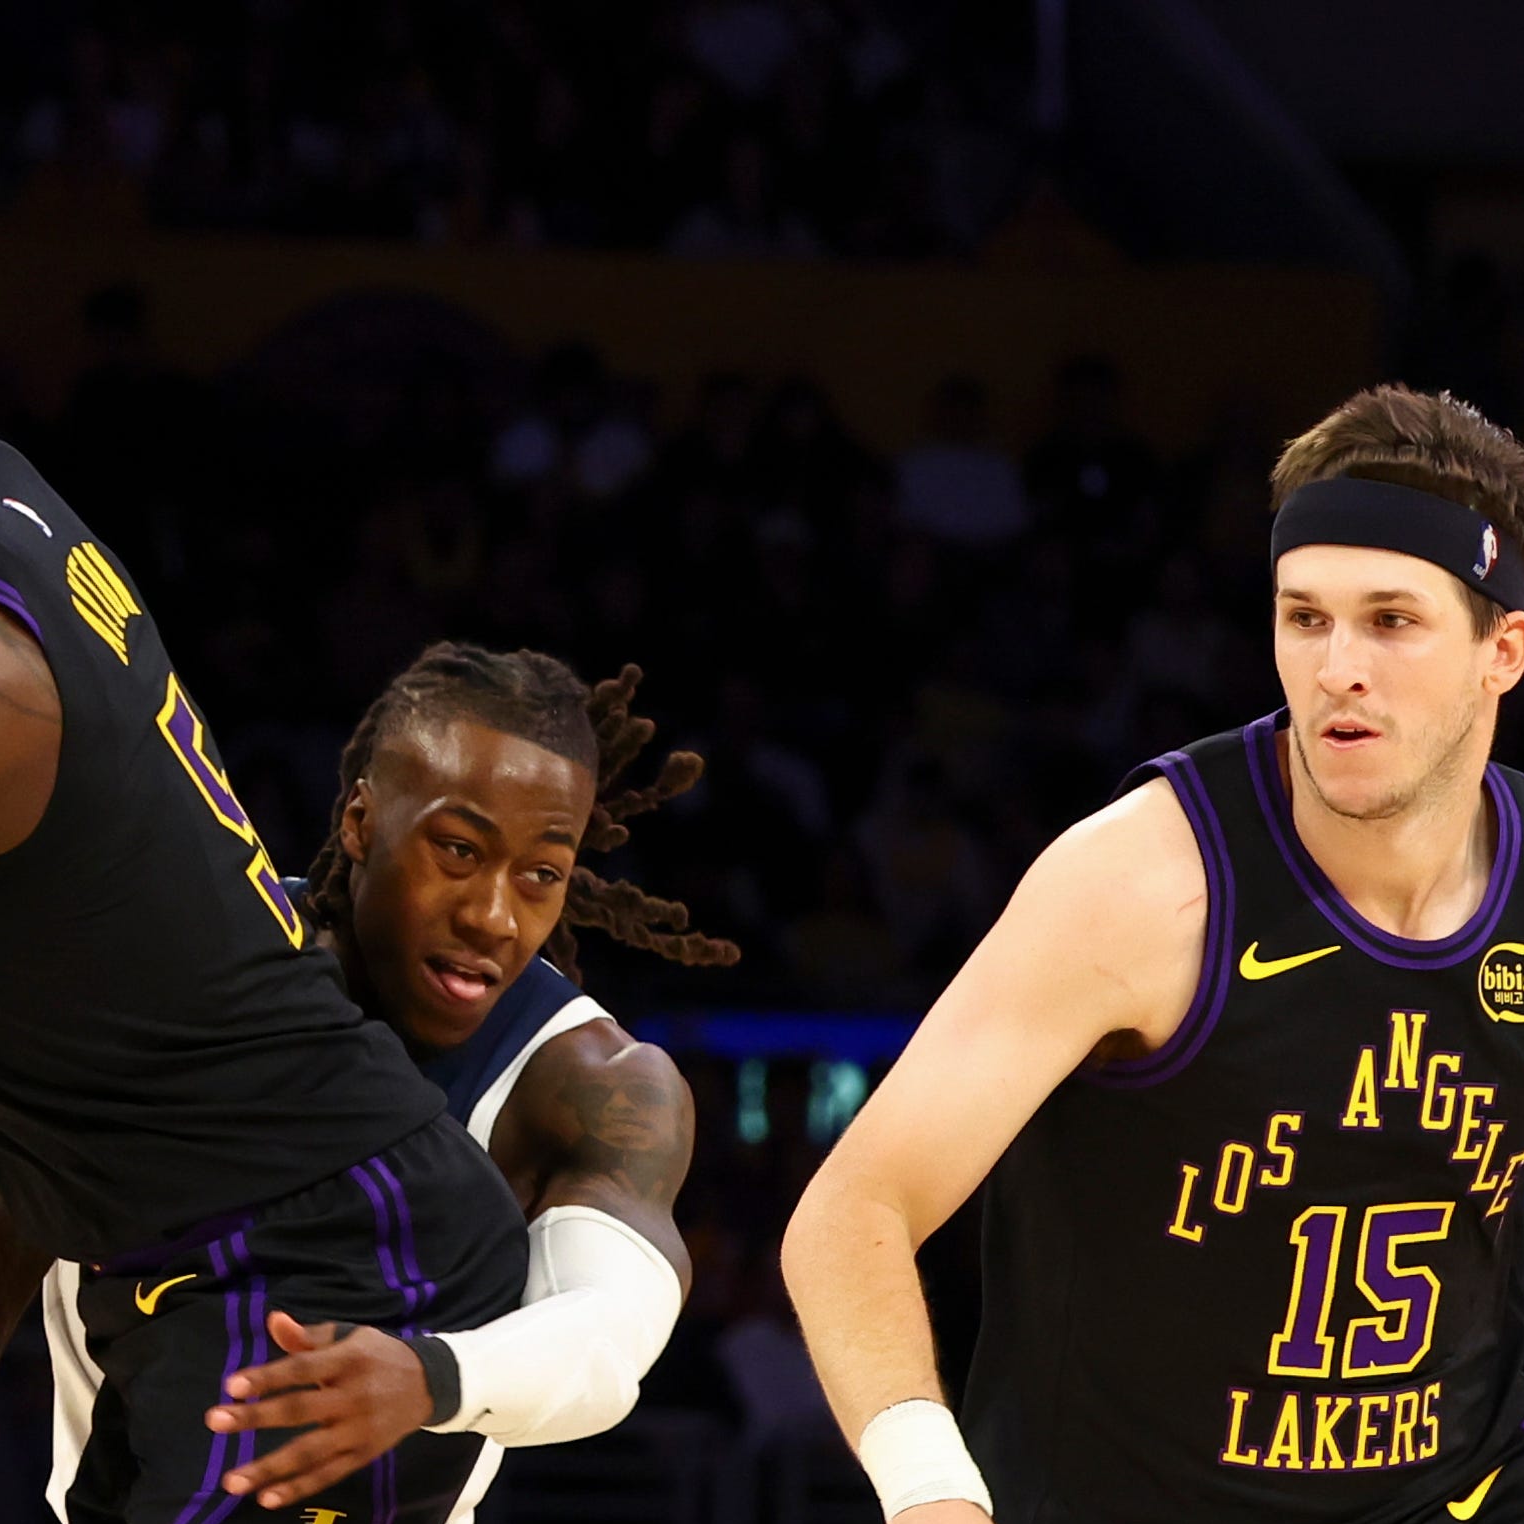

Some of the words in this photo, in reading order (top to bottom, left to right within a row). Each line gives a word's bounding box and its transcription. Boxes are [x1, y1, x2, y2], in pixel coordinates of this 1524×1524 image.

[1494, 991, 1524, 1005] 비비고
[1167, 1112, 1303, 1243] LOS
[1267, 1201, 1456, 1379] 15
[1220, 1382, 1442, 1471] LAKERS
